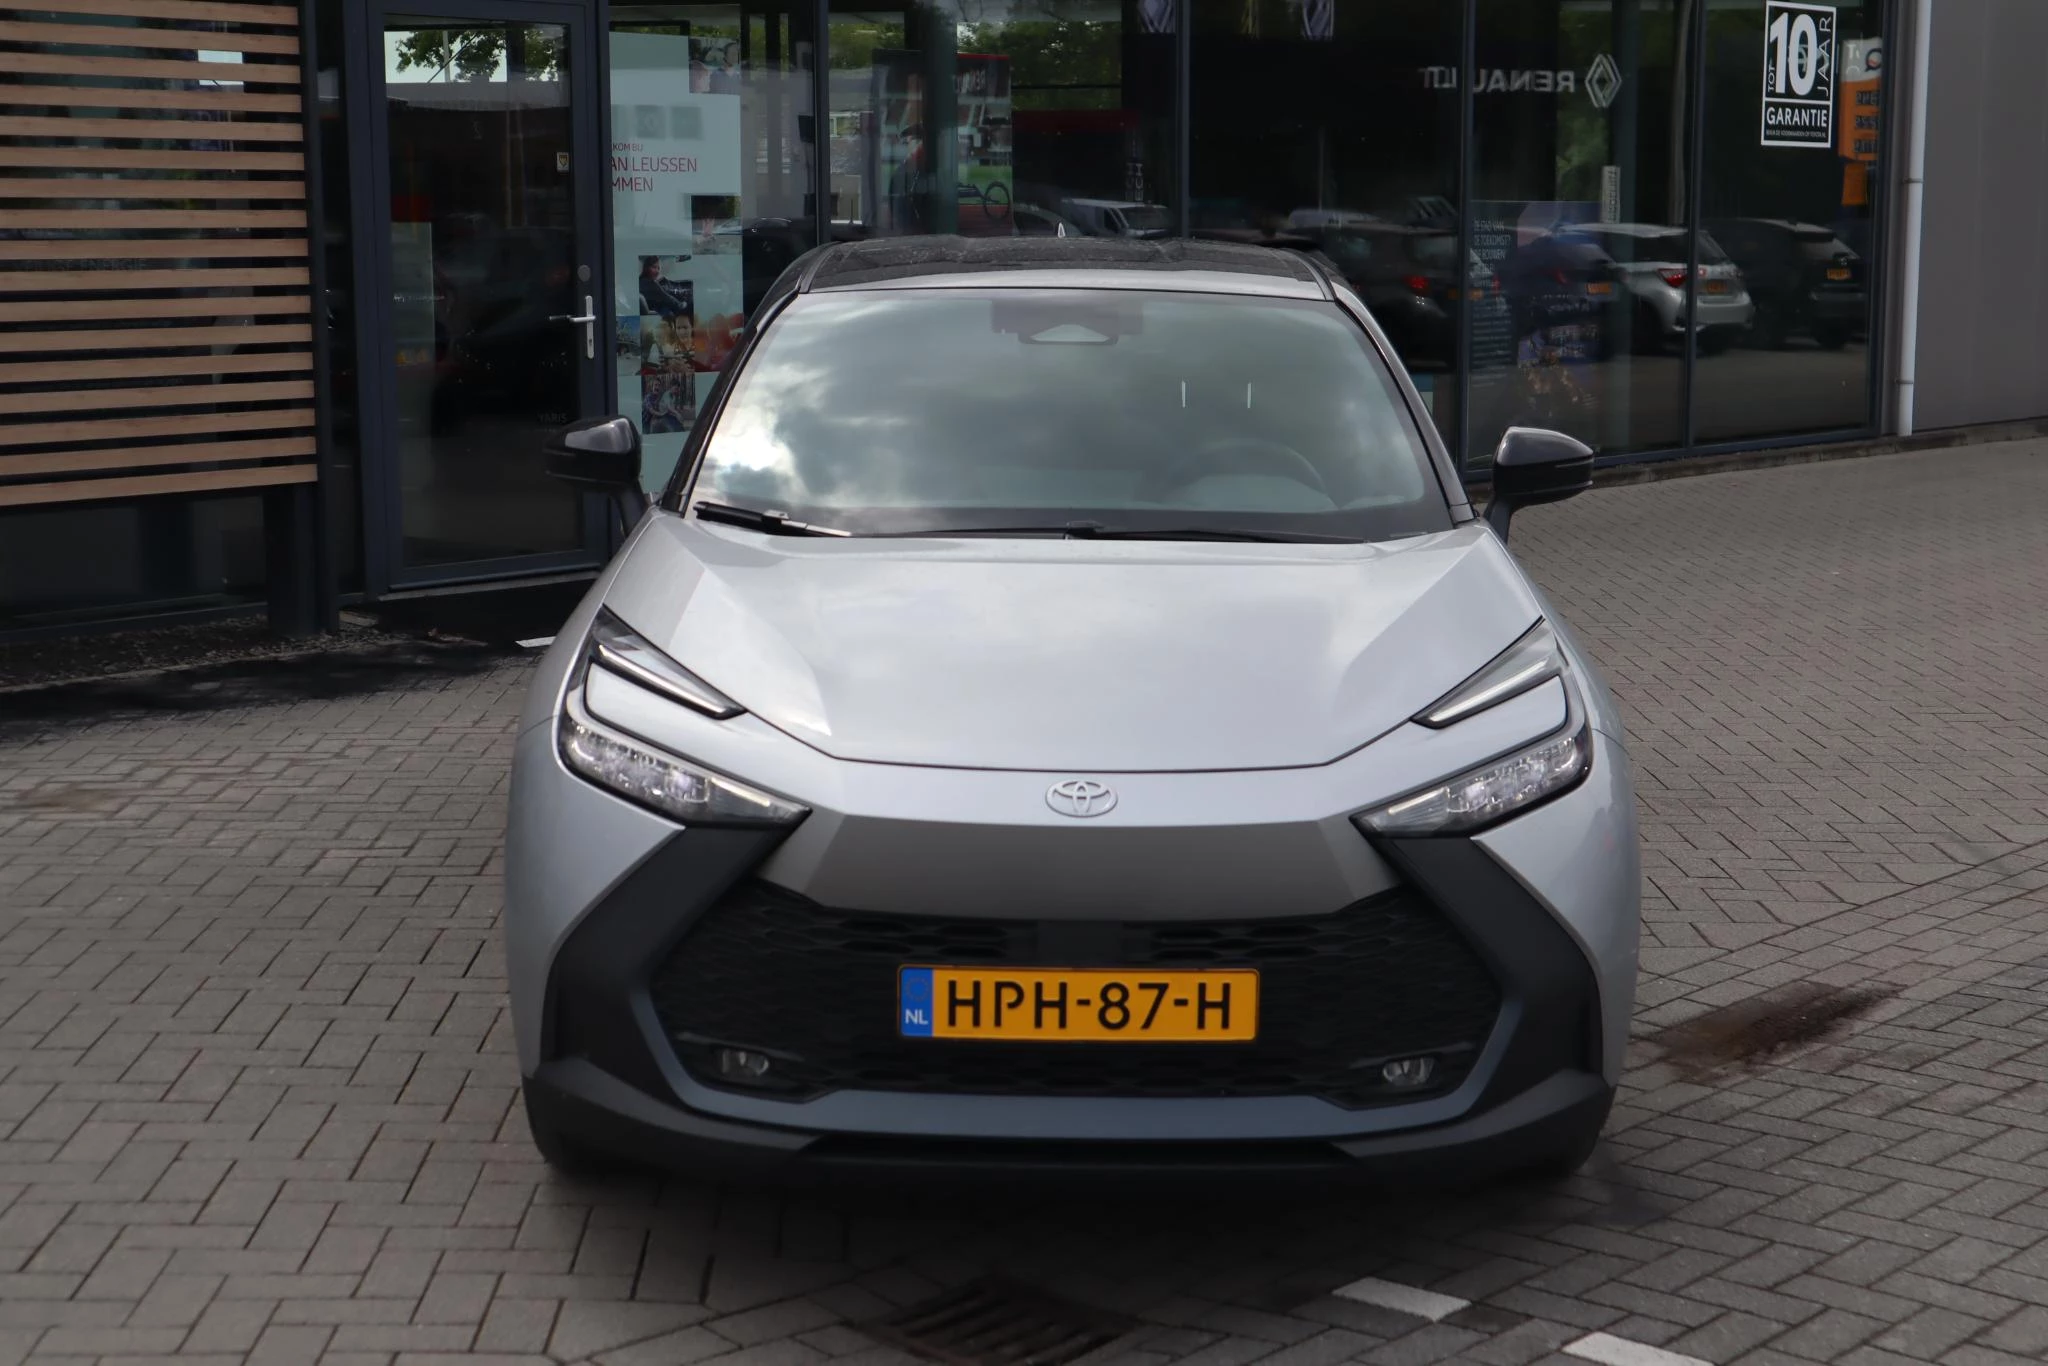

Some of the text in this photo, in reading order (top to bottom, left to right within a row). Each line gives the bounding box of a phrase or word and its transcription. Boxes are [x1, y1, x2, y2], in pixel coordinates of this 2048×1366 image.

[1769, 12, 1818, 96] 10
[1816, 16, 1832, 97] JAAR
[1767, 61, 1776, 94] TOT
[1766, 106, 1828, 128] GARANTIE
[612, 143, 644, 152] KOM BIJ
[610, 156, 697, 173] AN LEUSSEN
[611, 176, 654, 192] MMEN
[947, 980, 1232, 1030] HPH-87-H
[905, 1009, 929, 1025] NL
